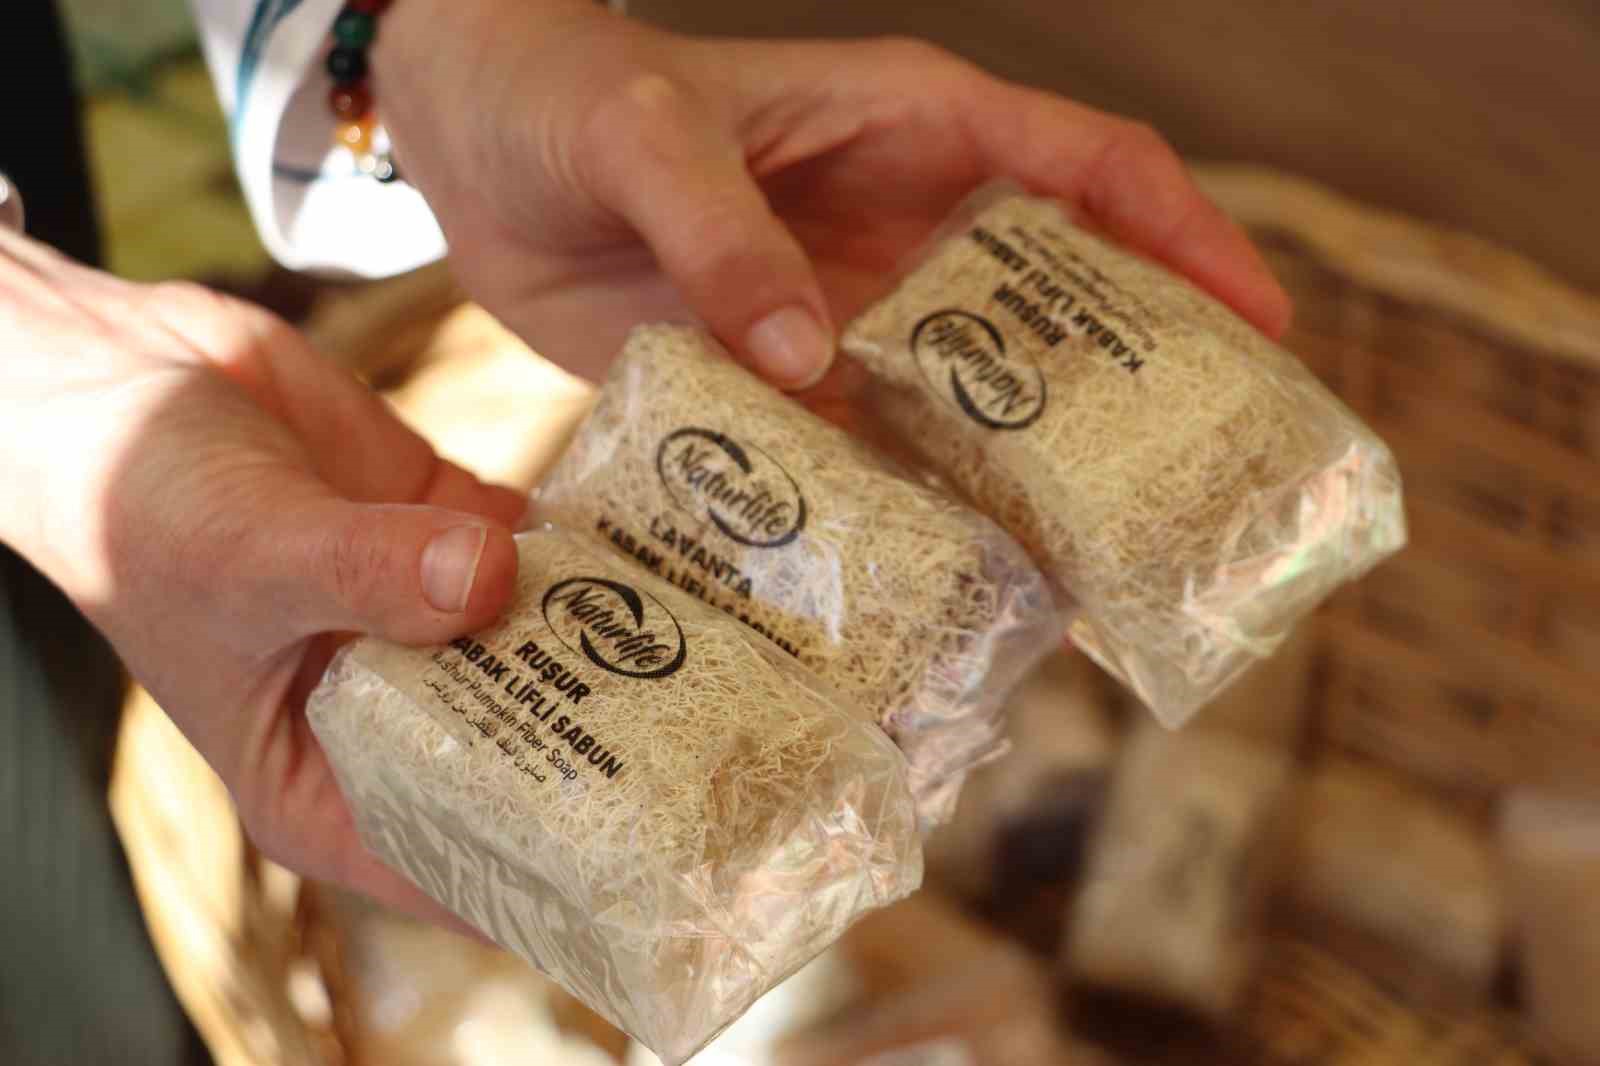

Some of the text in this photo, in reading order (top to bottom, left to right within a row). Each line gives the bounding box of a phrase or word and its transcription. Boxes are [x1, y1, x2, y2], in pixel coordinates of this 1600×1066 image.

[926, 319, 1037, 417] Naturlife
[1071, 306, 1146, 374] KABAK
[671, 443, 792, 536] Naturlife
[650, 515, 753, 600] LAVANTA
[552, 586, 673, 668] Naturlife
[446, 634, 624, 779] ABAK LİFLİ SABUN
[514, 640, 592, 704] RUŞUR
[465, 680, 519, 729] Pumpkin
[516, 720, 549, 753] Fiber
[545, 748, 579, 781] Soap
